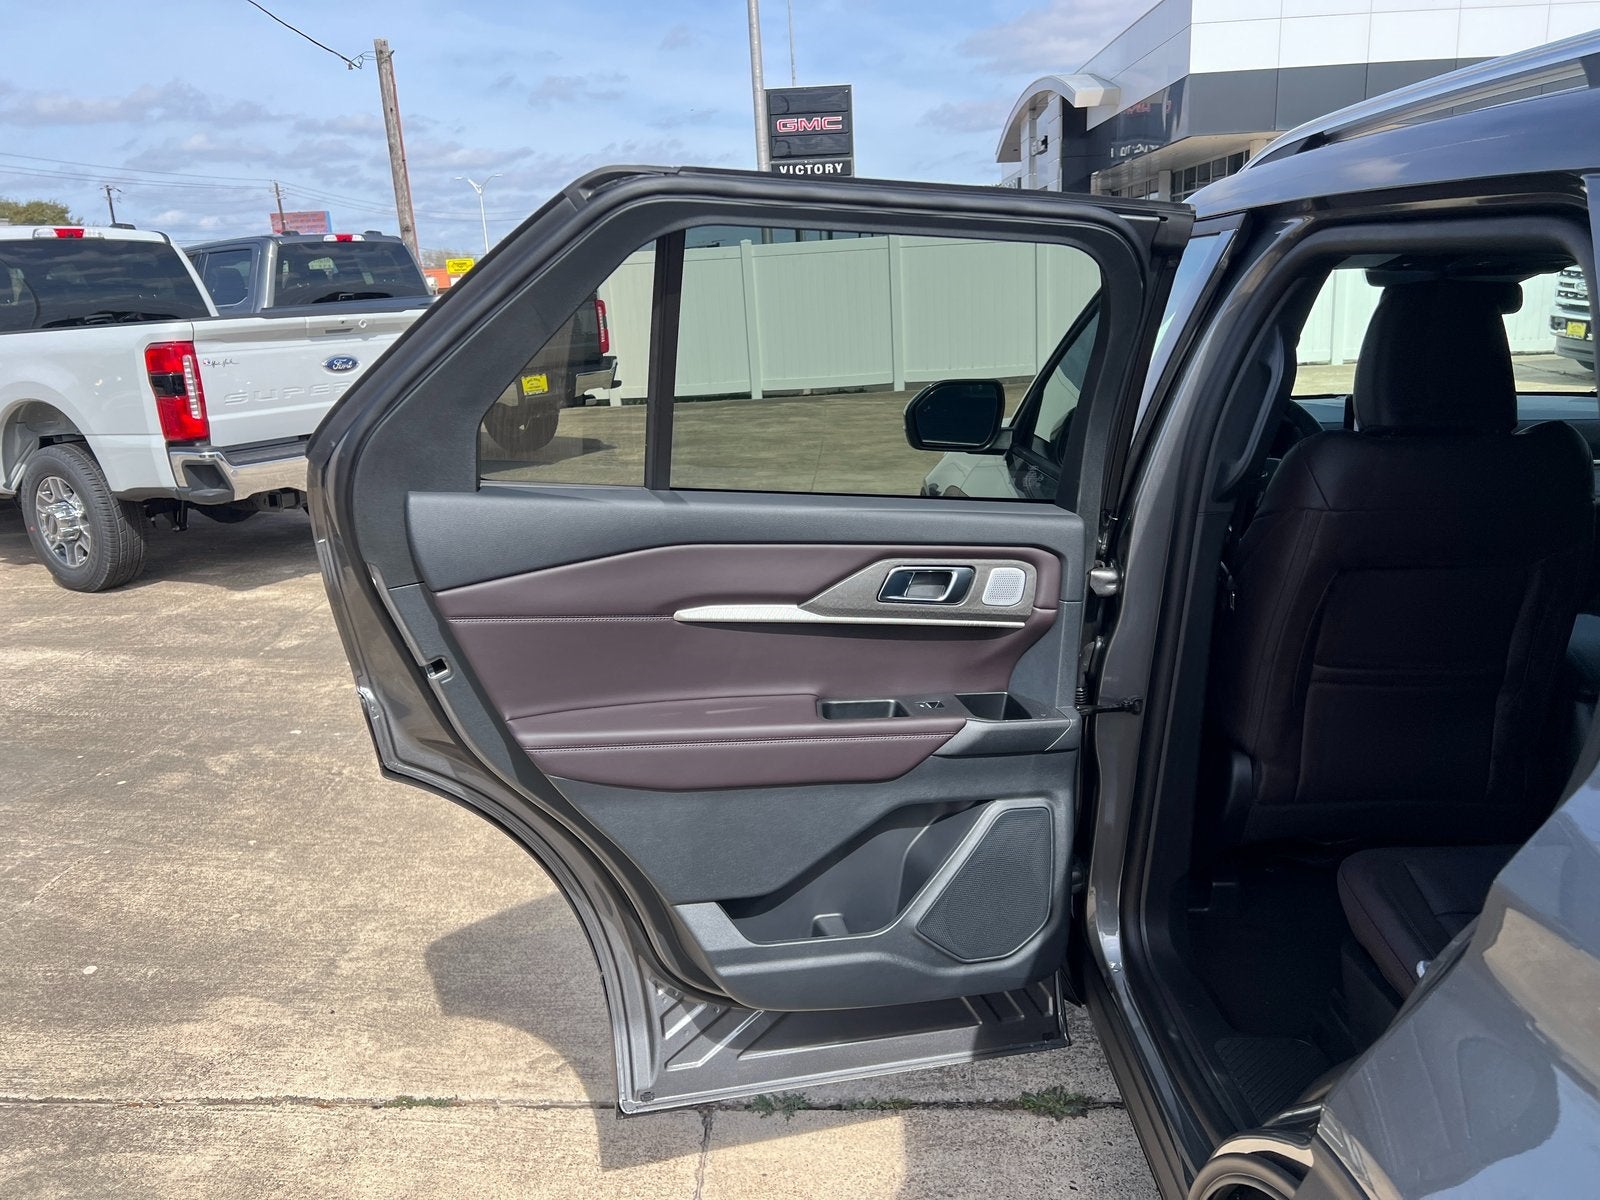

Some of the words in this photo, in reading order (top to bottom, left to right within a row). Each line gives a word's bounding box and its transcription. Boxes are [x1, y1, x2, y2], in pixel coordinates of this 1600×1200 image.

[776, 116, 843, 133] GMC
[779, 163, 843, 175] VICTORY
[332, 358, 353, 370] Ford
